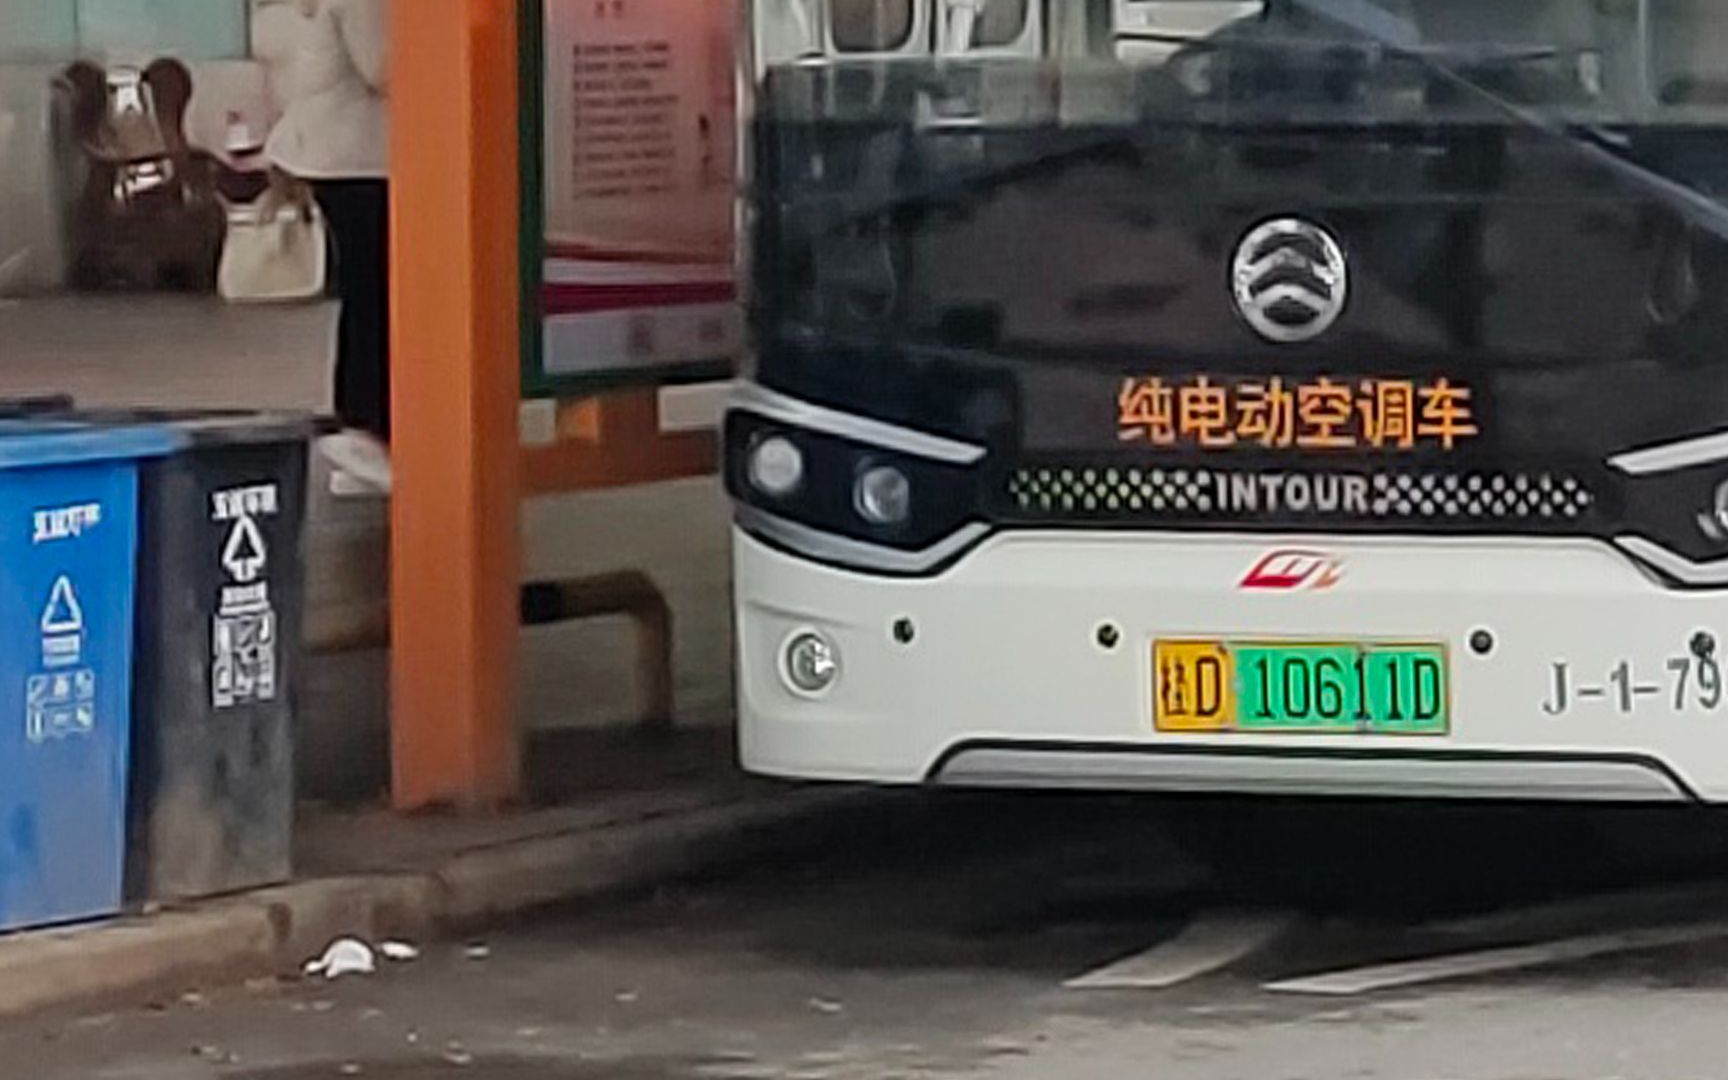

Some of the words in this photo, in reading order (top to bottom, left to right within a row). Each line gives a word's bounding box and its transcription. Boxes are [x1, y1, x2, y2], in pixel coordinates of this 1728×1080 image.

[1117, 376, 1480, 450] 纯电动空调车
[1217, 473, 1368, 513] INTOUR
[1253, 655, 1440, 721] 10611D
